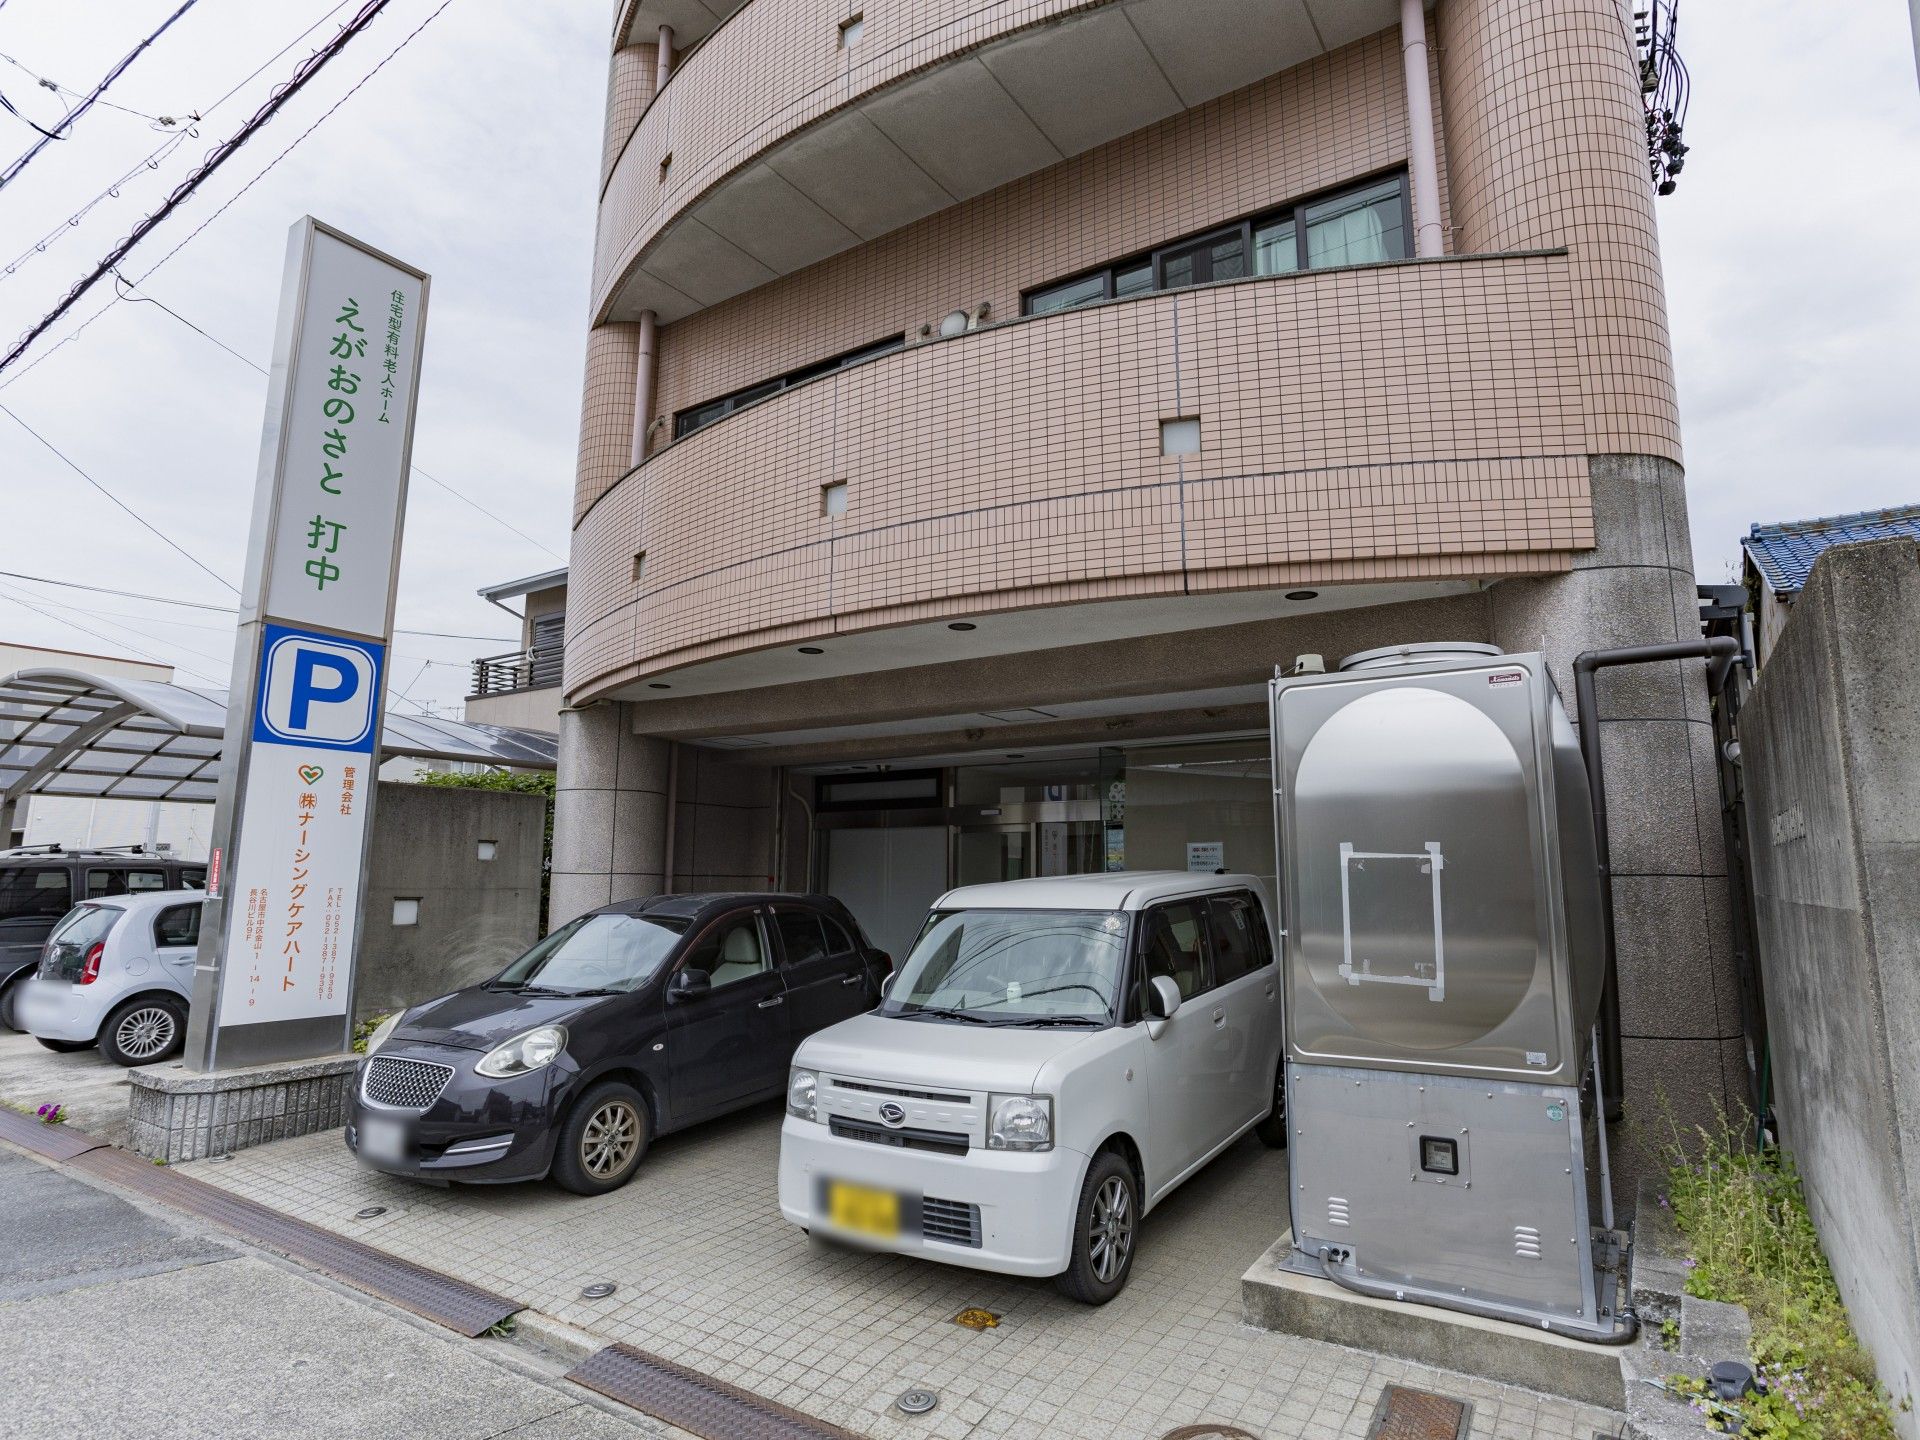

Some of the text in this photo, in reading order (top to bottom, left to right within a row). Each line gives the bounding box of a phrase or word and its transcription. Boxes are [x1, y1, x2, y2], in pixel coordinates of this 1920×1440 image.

[379, 289, 405, 424] 住宅型有料老人ホーム
[304, 297, 369, 591] えがおのさと 打中
[288, 648, 359, 730] P
[340, 766, 356, 816] 管理会社
